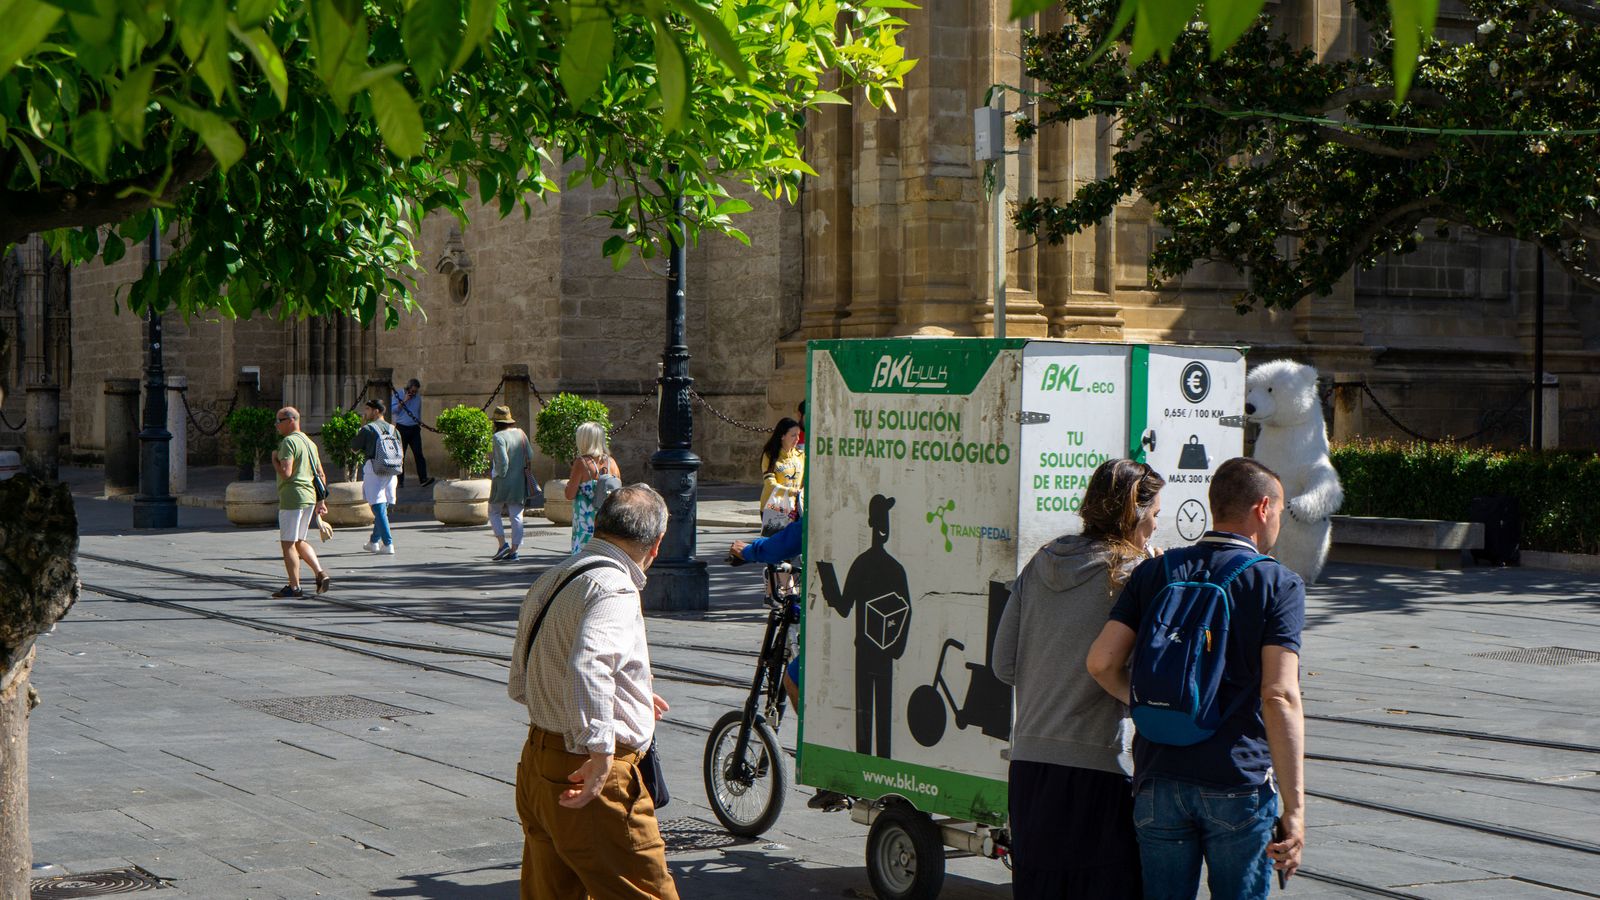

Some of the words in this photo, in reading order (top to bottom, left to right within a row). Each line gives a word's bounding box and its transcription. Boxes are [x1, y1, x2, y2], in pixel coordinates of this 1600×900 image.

[871, 355, 915, 388] BKL
[909, 365, 948, 381] HULK
[1040, 363, 1084, 392] BKL
[854, 409, 873, 429] TU
[878, 405, 961, 432] SOLUCIÓN
[1164, 408, 1187, 418] 0,65€
[1195, 409, 1210, 418] 100
[1211, 410, 1224, 418] KM
[1067, 431, 1083, 446] TU
[816, 436, 834, 456] DE
[838, 437, 906, 460] REPARTO
[911, 436, 1011, 465] ECOLÓGICO
[1033, 475, 1050, 490] DE
[1054, 475, 1092, 490] REPA
[1169, 474, 1187, 483] MAX
[1188, 475, 1203, 483] 300
[1036, 492, 1082, 512] ECOLÓ
[950, 524, 1011, 541] TRANSPEDAL
[862, 771, 938, 796] www.bkl.eco
